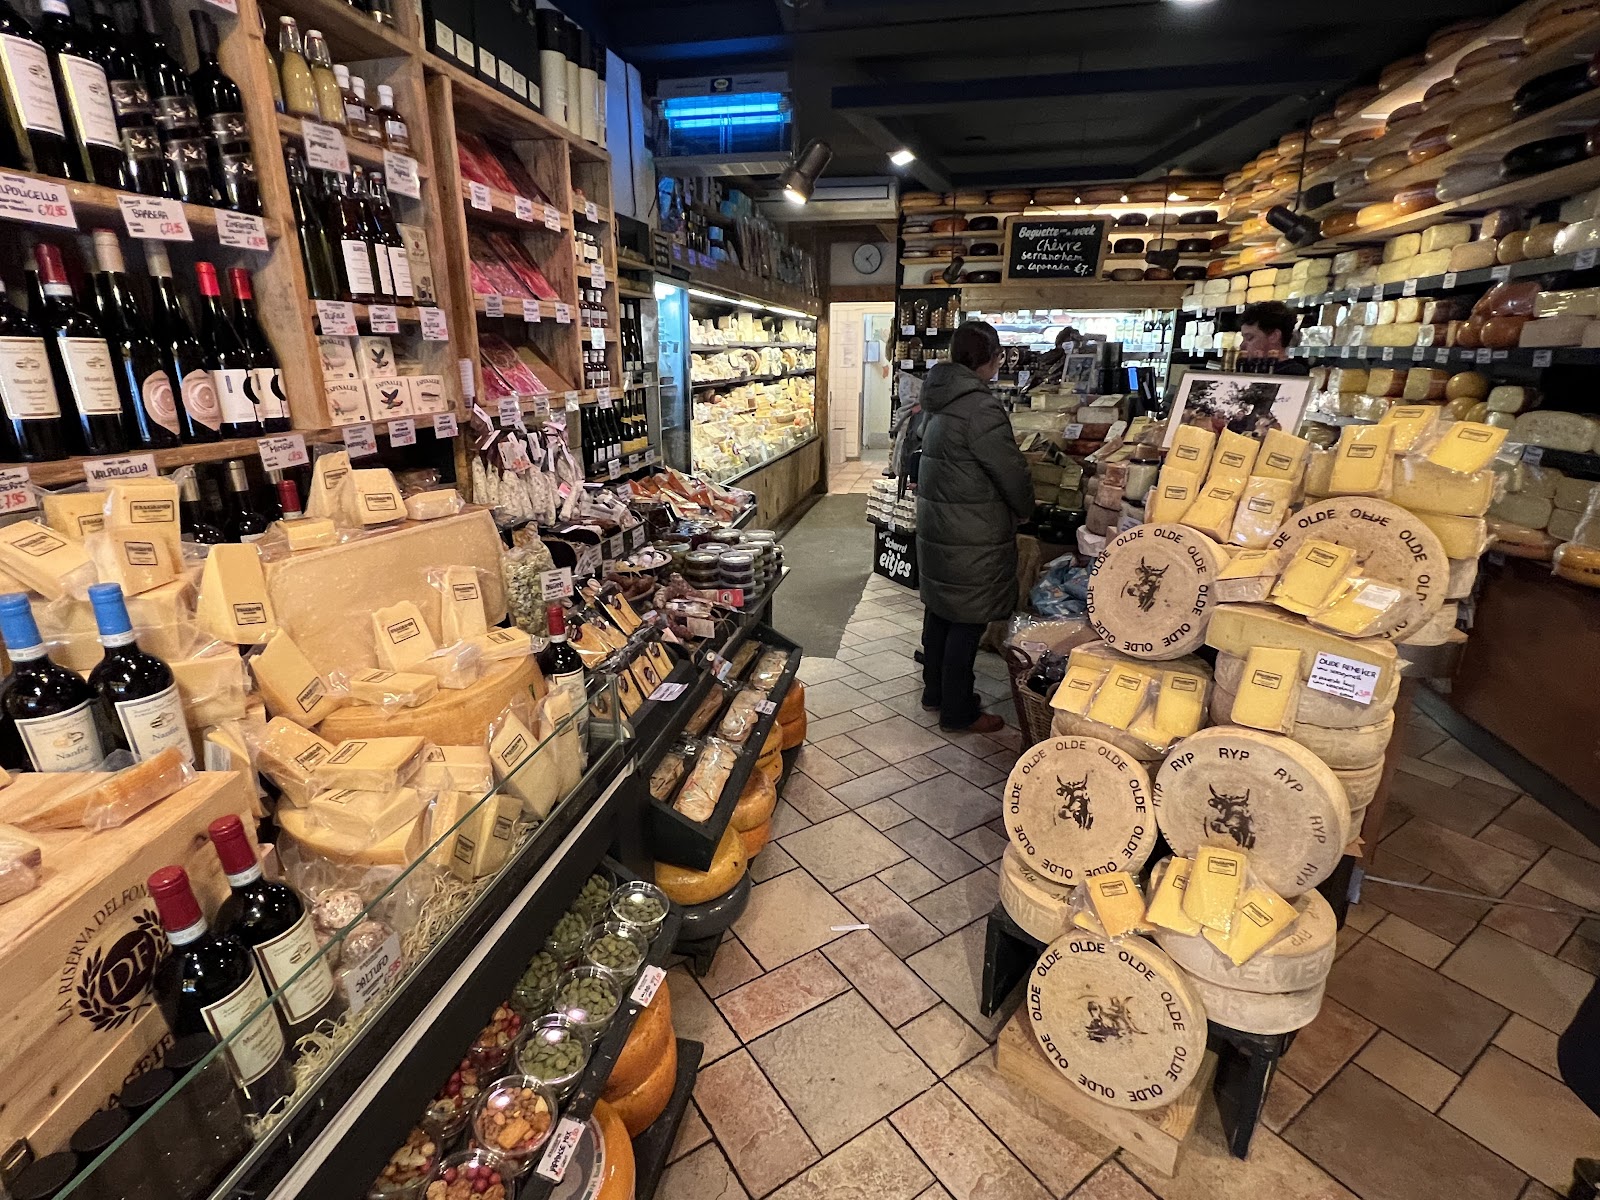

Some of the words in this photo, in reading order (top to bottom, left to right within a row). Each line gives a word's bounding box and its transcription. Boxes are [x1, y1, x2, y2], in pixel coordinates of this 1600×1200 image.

[1037, 239, 1082, 251] Chèvre
[91, 463, 148, 480] VALPOLICELLA
[1298, 509, 1336, 529] OLDE
[1116, 529, 1144, 547] OLDE
[1154, 528, 1183, 543] OLDE
[1399, 529, 1428, 563] OLDE
[879, 550, 912, 578] eitjes
[1091, 549, 1111, 577] OLDE
[1187, 546, 1207, 574] OLDE
[1086, 585, 1095, 613] OLDE
[1192, 584, 1208, 616] OLDE
[1093, 620, 1116, 643] OLDE
[1162, 623, 1191, 647] OLDE
[1123, 641, 1153, 652] OLDE
[1055, 740, 1087, 751] OLDE
[1098, 746, 1128, 771] OLDE
[1219, 747, 1250, 761] RYP
[1022, 749, 1047, 775] OLDE
[1170, 752, 1195, 772] RYP
[1274, 768, 1304, 793] RYP
[1011, 782, 1023, 814] OLDE
[1129, 779, 1146, 813] OLDE
[1014, 824, 1036, 856] OLDE
[1121, 825, 1144, 859] OLDE
[1309, 815, 1327, 844] RYP
[1041, 858, 1073, 879] OLDE
[1296, 862, 1319, 886] RYP
[93, 897, 120, 925] DEL
[58, 926, 95, 996] RISERVA
[1070, 941, 1105, 954] OLDE
[103, 936, 149, 1000] DF
[1037, 949, 1063, 977] OLDE
[1119, 951, 1156, 982] OLDE
[57, 998, 75, 1026] LA
[1031, 984, 1042, 1021] OLDE
[1161, 991, 1186, 1032] OLDE
[1040, 1033, 1069, 1069] OLDE
[1165, 1046, 1187, 1082] OLDE
[1077, 1073, 1115, 1099] OLDE
[1127, 1083, 1163, 1102] OLDE
